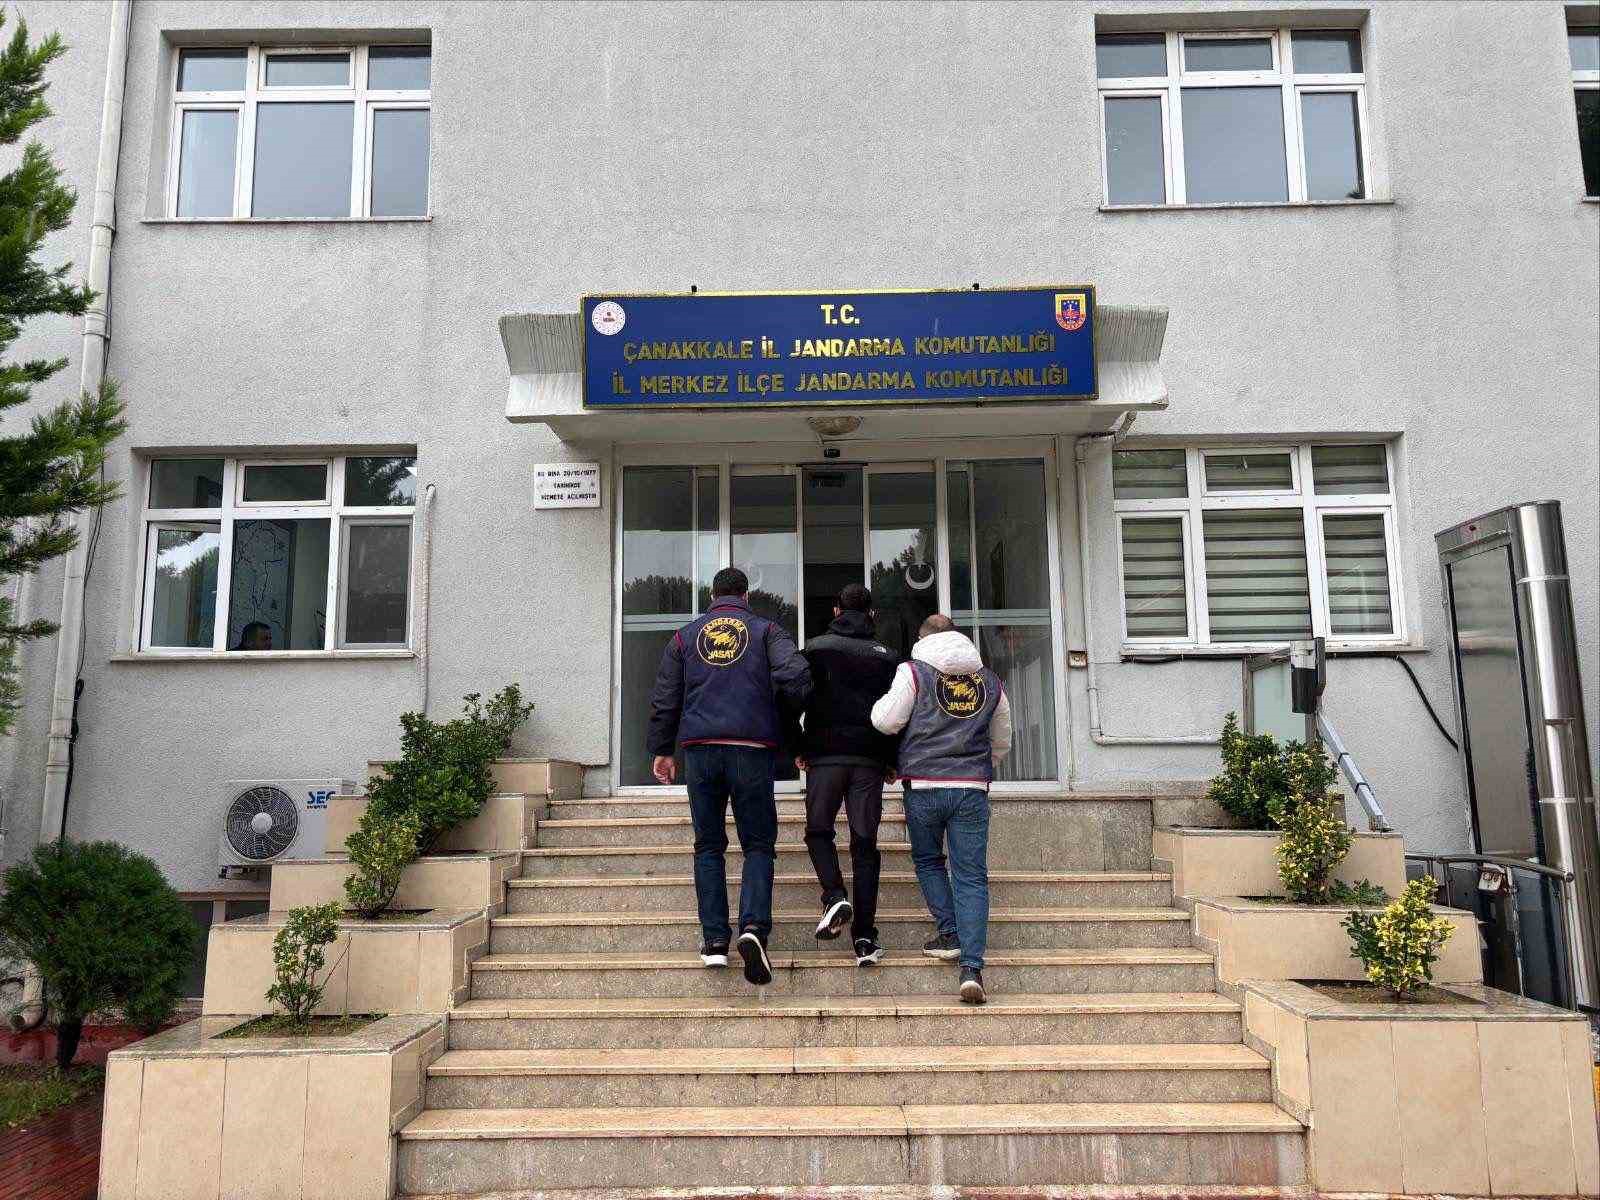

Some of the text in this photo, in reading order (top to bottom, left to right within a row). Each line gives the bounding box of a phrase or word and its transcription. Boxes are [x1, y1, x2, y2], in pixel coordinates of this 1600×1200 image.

[820, 303, 860, 325] T.C.
[623, 329, 1056, 365] ÇANAKKALE İL JANDARMA KOMUTANLIĞI
[612, 363, 1069, 398] İL MERKEZ İLÇE JANDARMA KOMUTANLIĞI
[707, 649, 736, 660] JASAT
